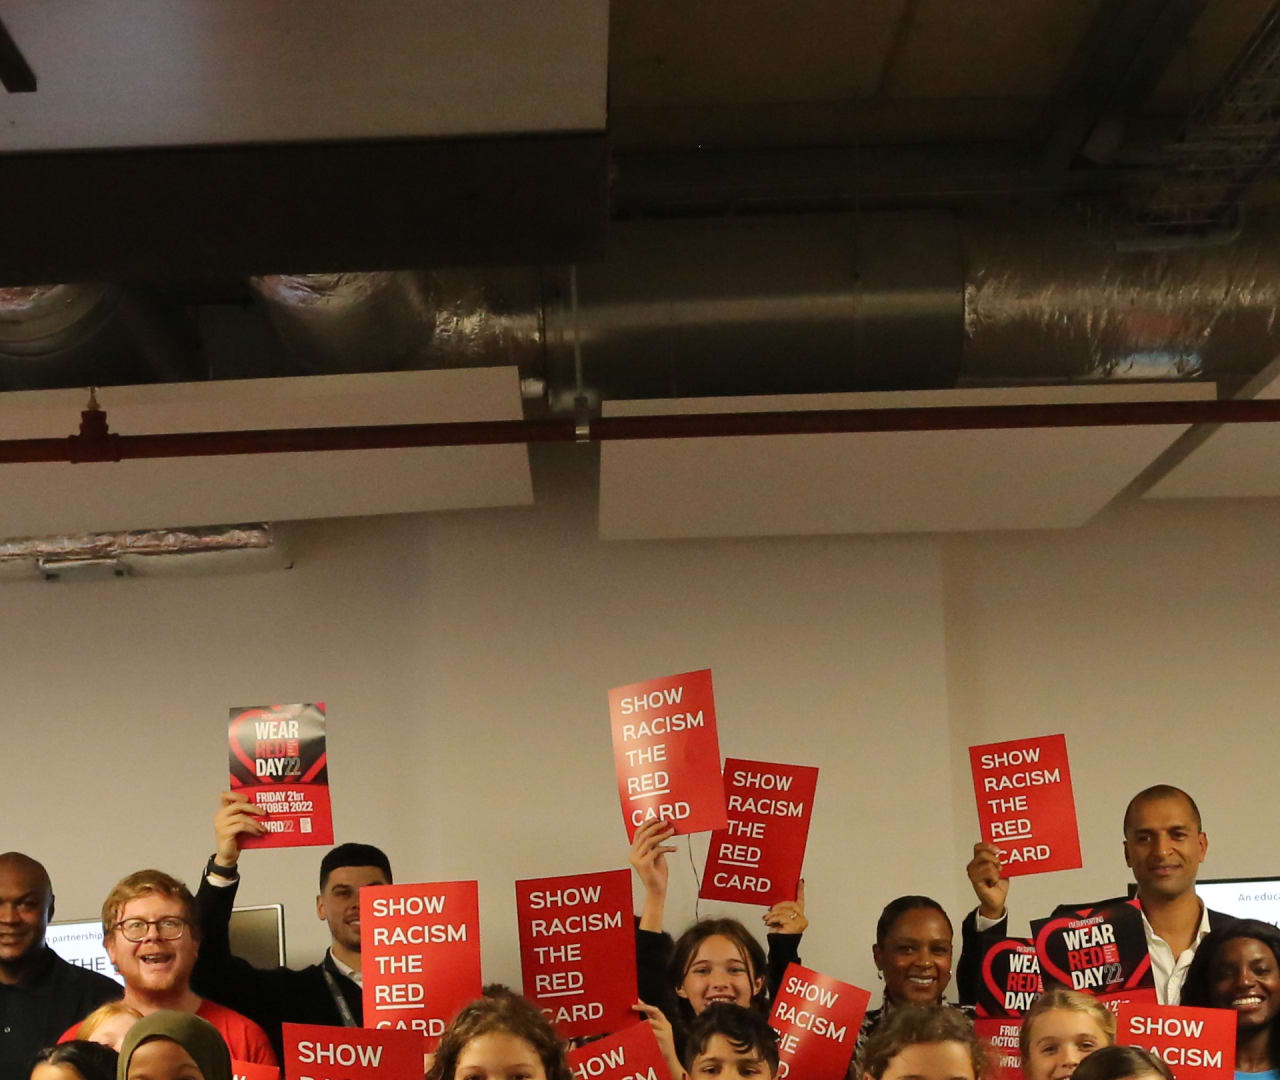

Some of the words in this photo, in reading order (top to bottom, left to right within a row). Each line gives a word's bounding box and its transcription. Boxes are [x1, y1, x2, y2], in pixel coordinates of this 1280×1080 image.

[620, 687, 682, 715] SHOW
[256, 721, 299, 739] WEAR
[623, 712, 704, 740] RACISM
[625, 744, 666, 766] THE
[982, 748, 1039, 769] SHOW
[628, 772, 668, 794] RED
[733, 771, 792, 791] SHOW
[985, 768, 1060, 792] RACISM
[256, 792, 286, 802] FRIDAY
[290, 801, 312, 812] 2022
[729, 796, 803, 817] RACISM
[988, 796, 1027, 813] THE
[727, 820, 765, 838] THE
[991, 818, 1031, 838] RED
[720, 844, 760, 861] RED
[714, 873, 770, 892] CARD
[53, 932, 102, 947] partnership
[1063, 924, 1115, 950] WEAR
[1010, 954, 1040, 973] WEA
[1068, 946, 1104, 971] RED
[1008, 973, 1038, 991] RED
[298, 1042, 382, 1067] SHOW
